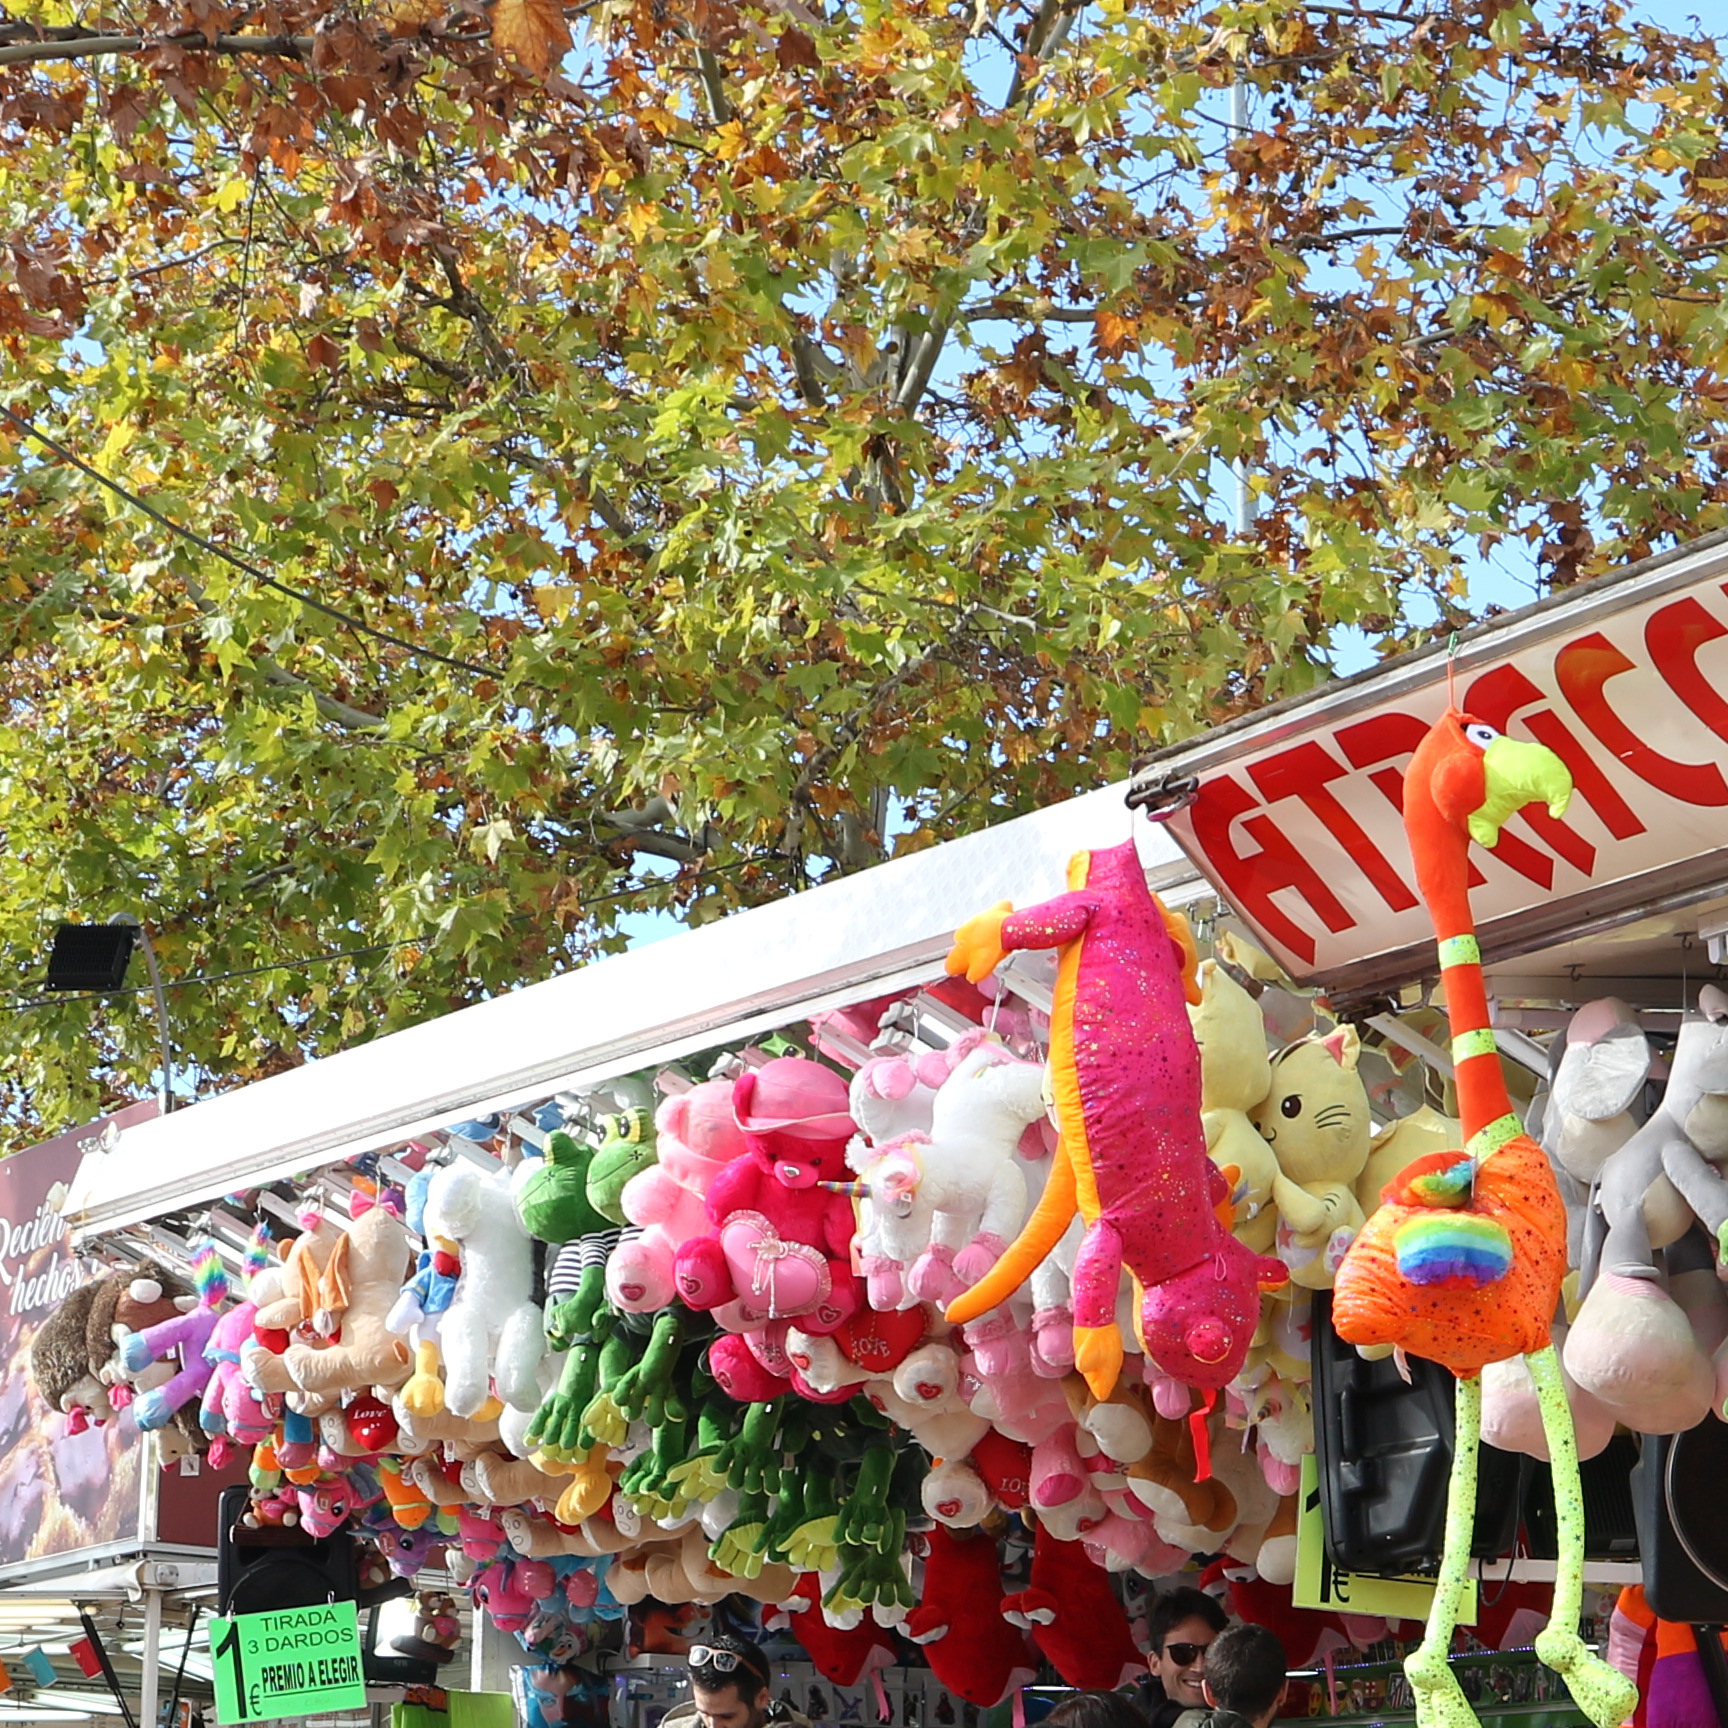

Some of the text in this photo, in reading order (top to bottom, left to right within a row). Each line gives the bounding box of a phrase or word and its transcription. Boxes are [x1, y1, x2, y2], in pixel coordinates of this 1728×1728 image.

[851, 1336, 890, 1359] LOVE
[353, 1410, 387, 1420] Love
[260, 1610, 337, 1632] TIRADA
[248, 1628, 353, 1655] 3 DARDOS
[216, 1621, 248, 1719] 1
[261, 1655, 360, 1694] PREMIO A ELEGIR
[249, 1683, 262, 1716] €
